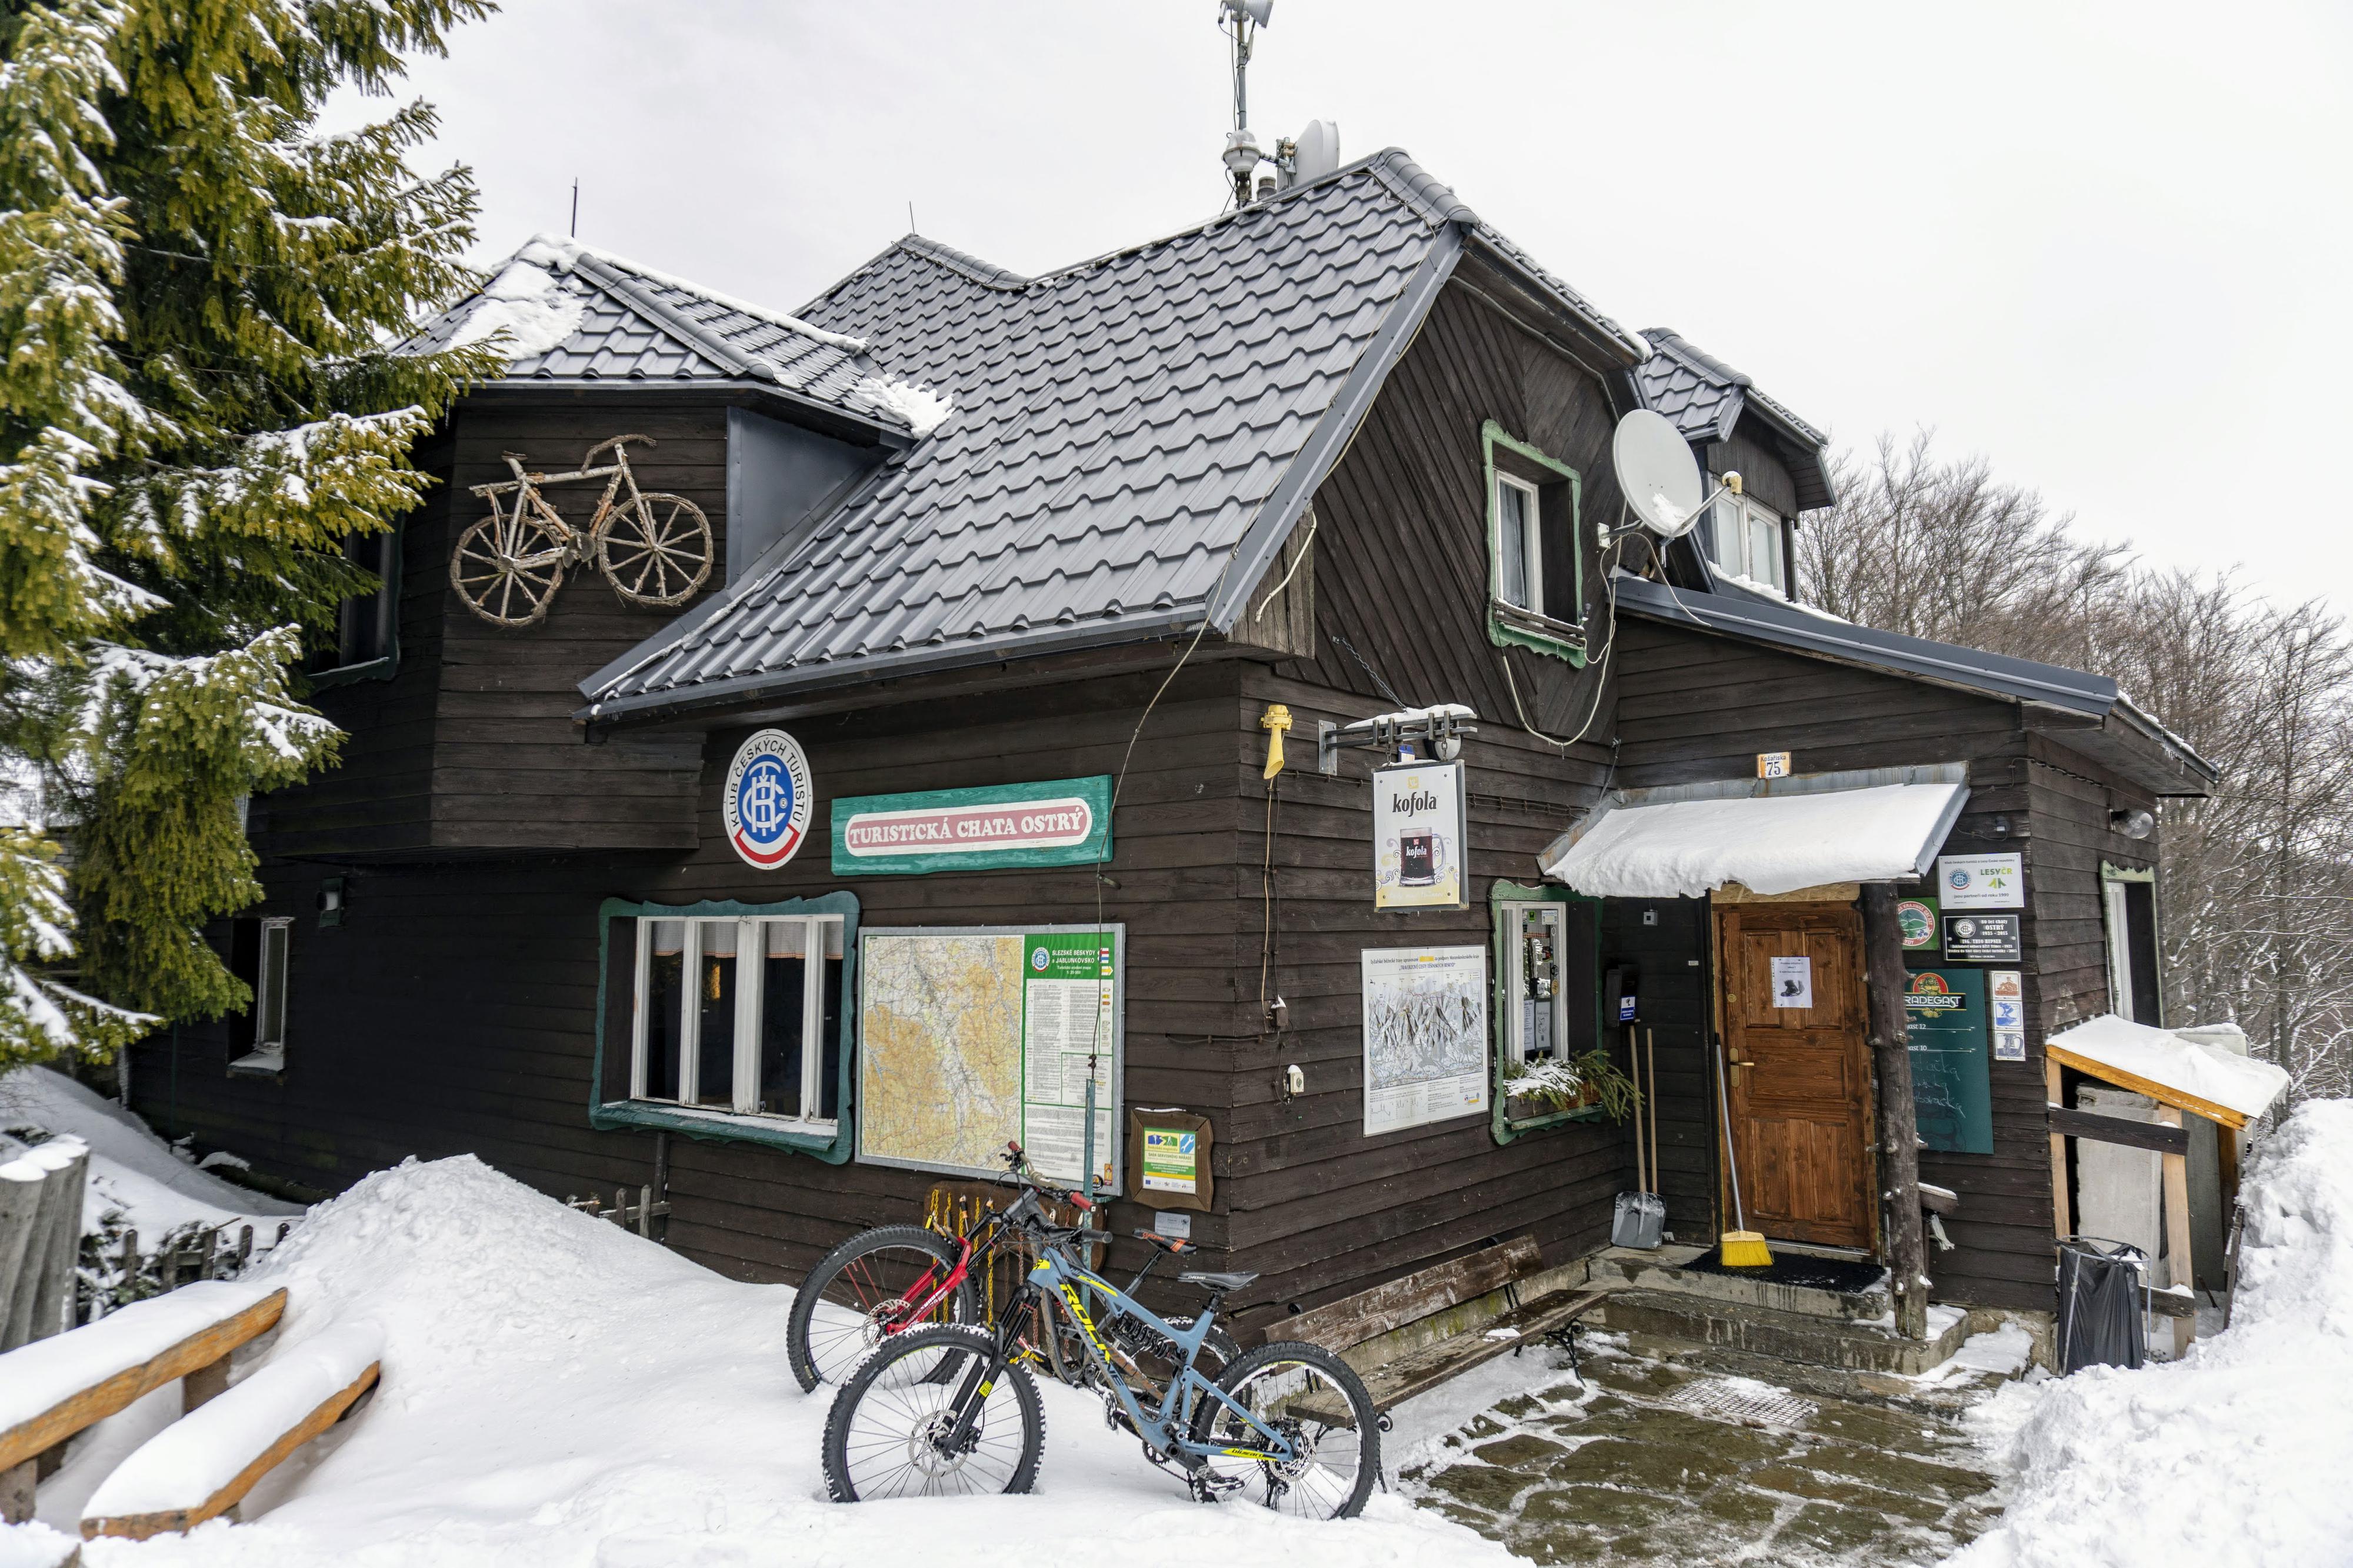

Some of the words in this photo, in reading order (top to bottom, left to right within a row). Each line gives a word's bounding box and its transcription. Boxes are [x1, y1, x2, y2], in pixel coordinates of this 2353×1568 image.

[729, 783, 739, 827] KLUB
[735, 738, 787, 778] ČESKÝCH
[786, 752, 805, 823] TURISTŮ
[1767, 761, 1781, 776] 75
[1392, 790, 1437, 817] kofola
[850, 817, 953, 845] TURISTICKÁ
[956, 818, 1018, 838] CHATA
[1021, 806, 1084, 834] OSTRÝ
[1406, 845, 1427, 859] kofola
[1059, 1283, 1111, 1364] ROCK
